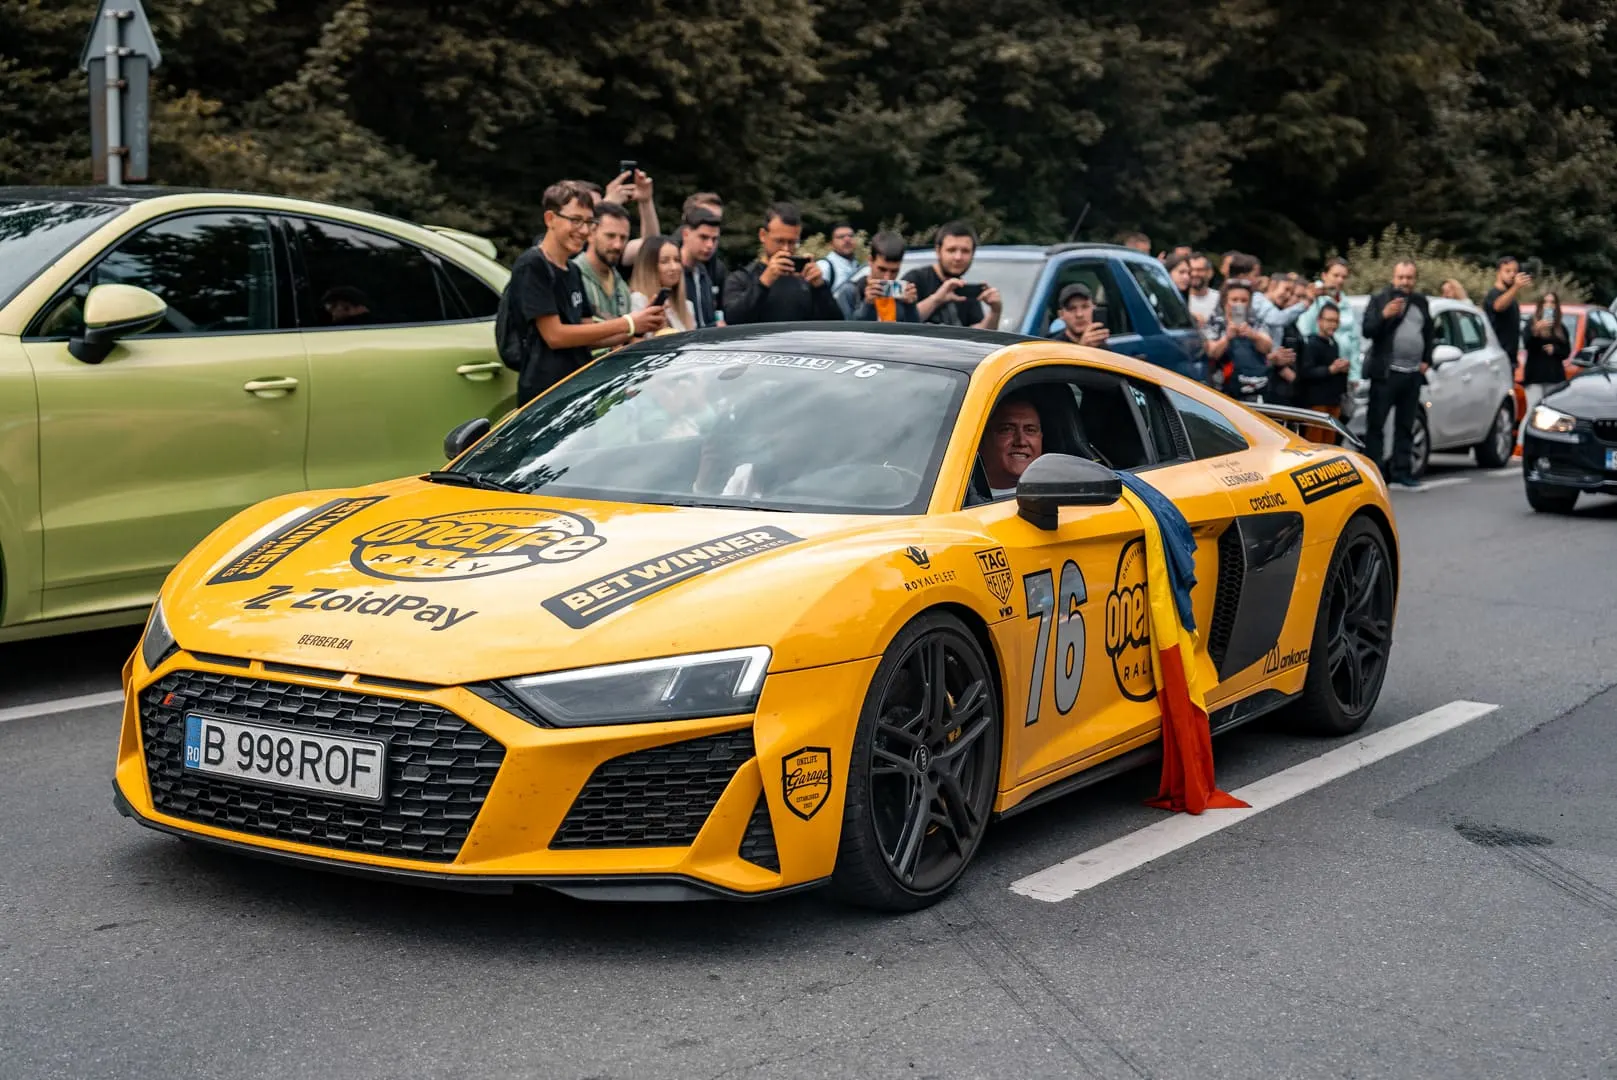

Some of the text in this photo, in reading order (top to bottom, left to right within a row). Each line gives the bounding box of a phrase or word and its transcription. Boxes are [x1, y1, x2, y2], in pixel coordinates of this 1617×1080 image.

[834, 359, 884, 378] 76
[1220, 471, 1264, 487] LEONARDO
[1296, 460, 1354, 489] BETWINNER
[238, 499, 374, 575] BETWINNER
[369, 552, 490, 572] RALLY
[711, 539, 790, 566] AFFILIATES
[979, 550, 1006, 572] TAG
[560, 531, 777, 610] BETWINNER
[984, 571, 1013, 601] HEUER
[290, 588, 479, 632] ZoidPay
[998, 605, 1014, 618] V10
[297, 634, 354, 651] BERBER.BA
[1022, 559, 1088, 728] 76
[187, 745, 200, 763] RO
[204, 724, 226, 766] B
[797, 755, 818, 767] ONELIFE
[783, 767, 831, 792] Garage
